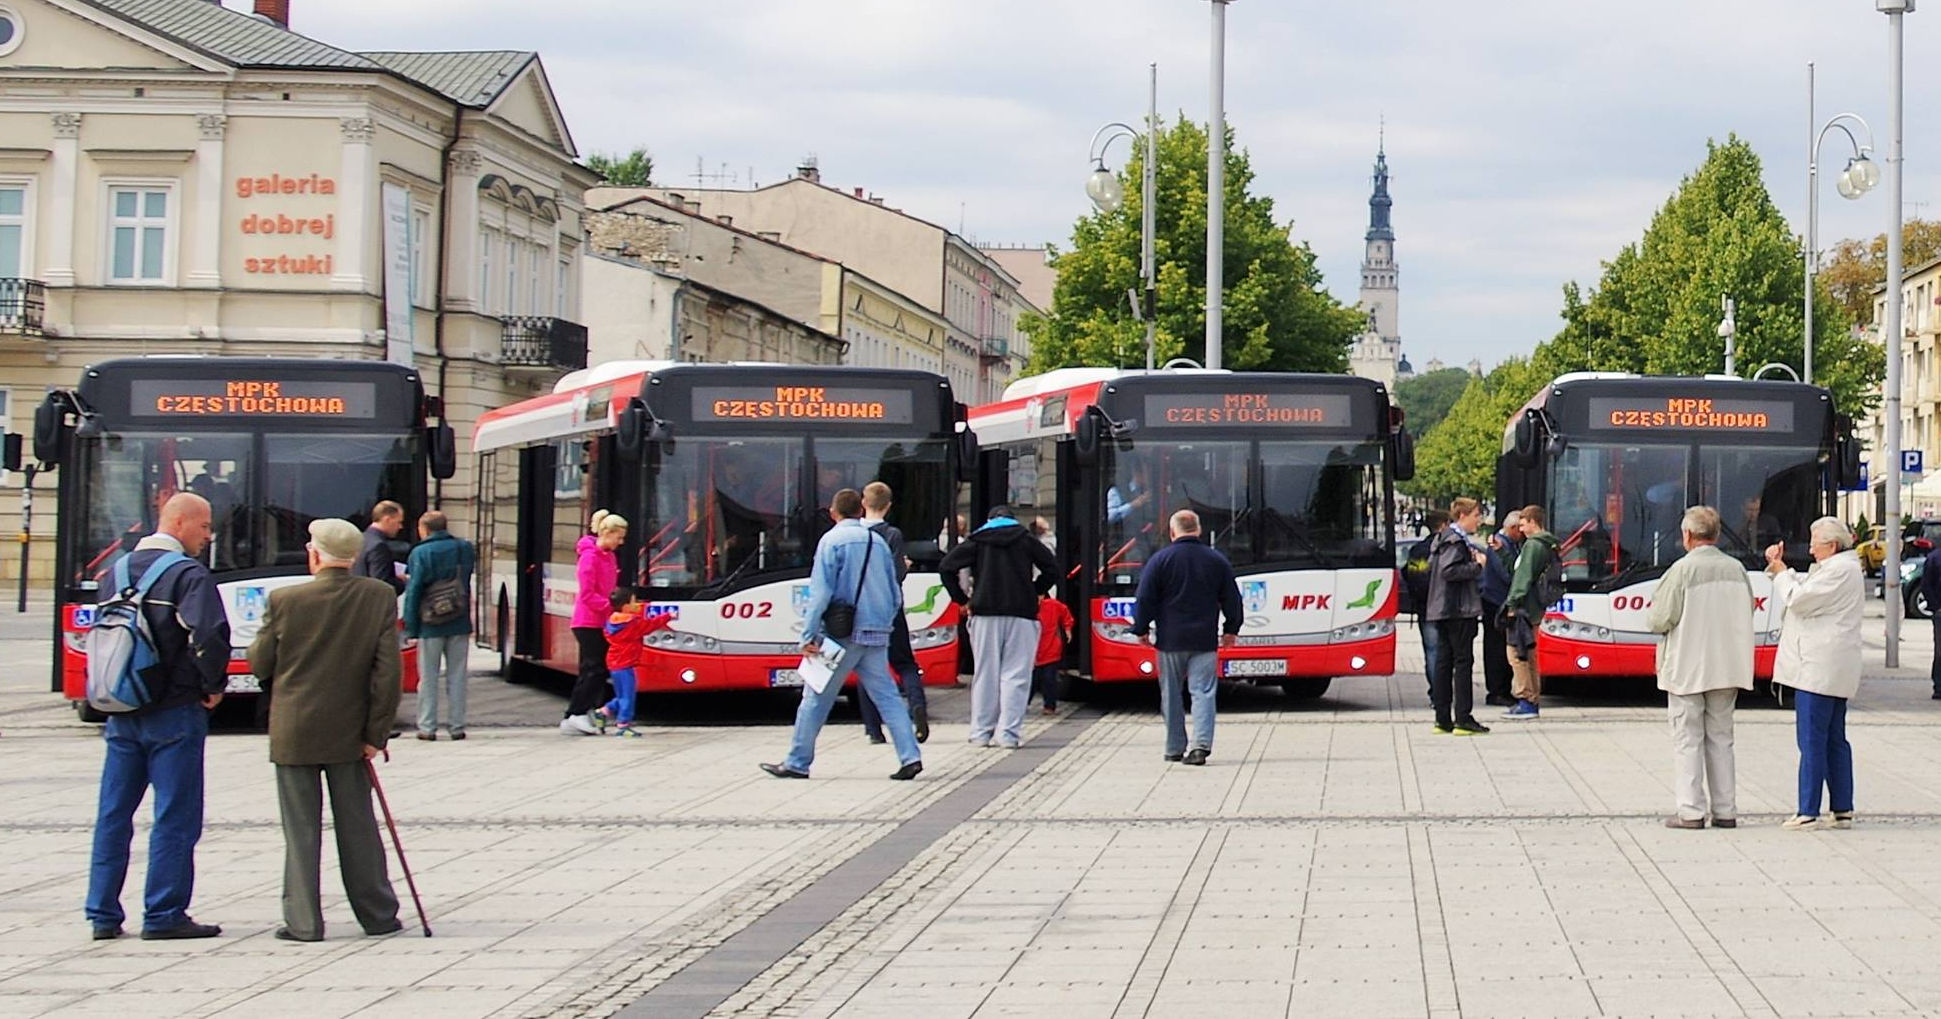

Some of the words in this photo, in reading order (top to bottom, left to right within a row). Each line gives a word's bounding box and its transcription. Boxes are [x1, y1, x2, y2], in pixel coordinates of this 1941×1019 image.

[236, 173, 335, 198] galeria
[241, 214, 334, 239] dobrej
[244, 254, 332, 274] sztuki
[226, 382, 280, 397] MPK
[776, 387, 826, 402] MPK
[157, 396, 345, 414] CZĘSTOCHOWA
[713, 401, 885, 418] CZĘSTOCHOWA
[1223, 394, 1269, 408] MPK
[1668, 399, 1713, 413] MPK
[1166, 408, 1324, 424] CZĘSTOCHOWA
[1610, 411, 1769, 428] CZĘSTOCHOWA
[1904, 452, 1920, 471] P
[721, 602, 774, 619] 002
[1281, 594, 1332, 611] MPK
[1613, 596, 1652, 611] 00
[1230, 662, 1246, 674] SC
[778, 671, 795, 683] SC
